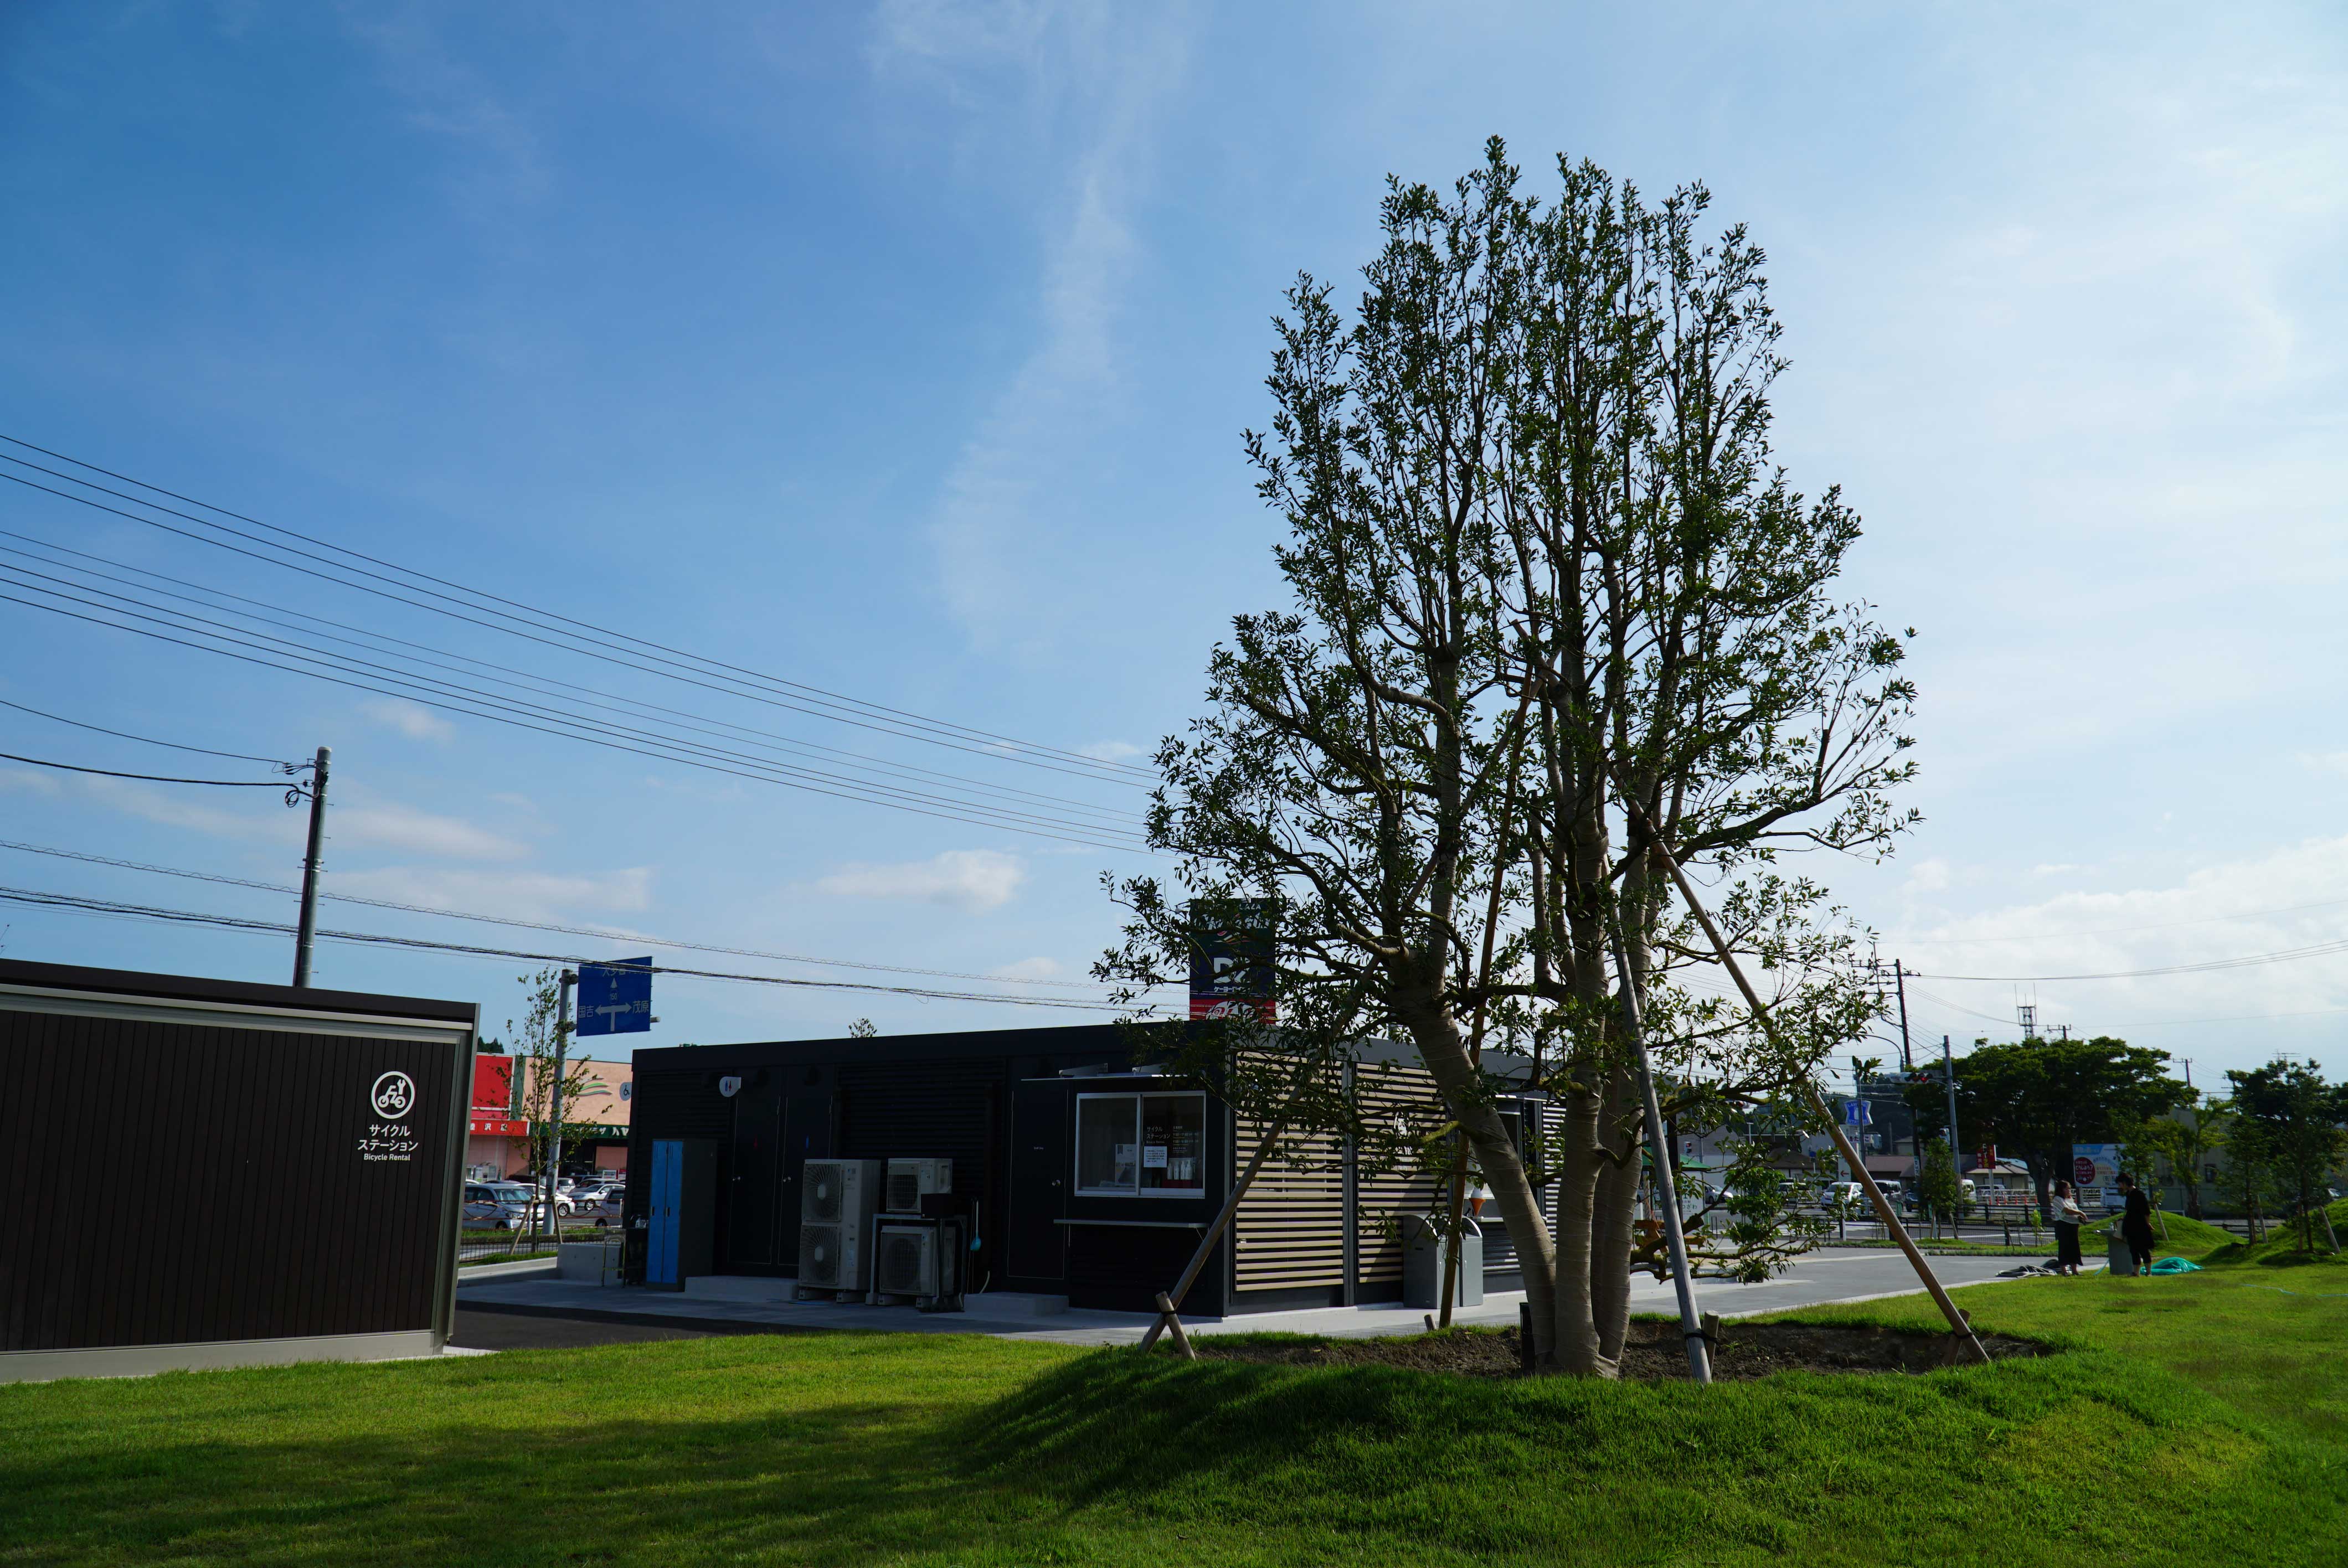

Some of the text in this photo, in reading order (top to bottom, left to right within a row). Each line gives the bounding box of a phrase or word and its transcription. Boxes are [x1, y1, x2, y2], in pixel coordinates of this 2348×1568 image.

[610, 992, 618, 1000] 150
[578, 1005, 595, 1018] 国吉
[632, 1000, 650, 1014] 茂原
[369, 1124, 411, 1137] サイクル
[357, 1139, 419, 1151] ステーション
[364, 1153, 388, 1162] Bicycle
